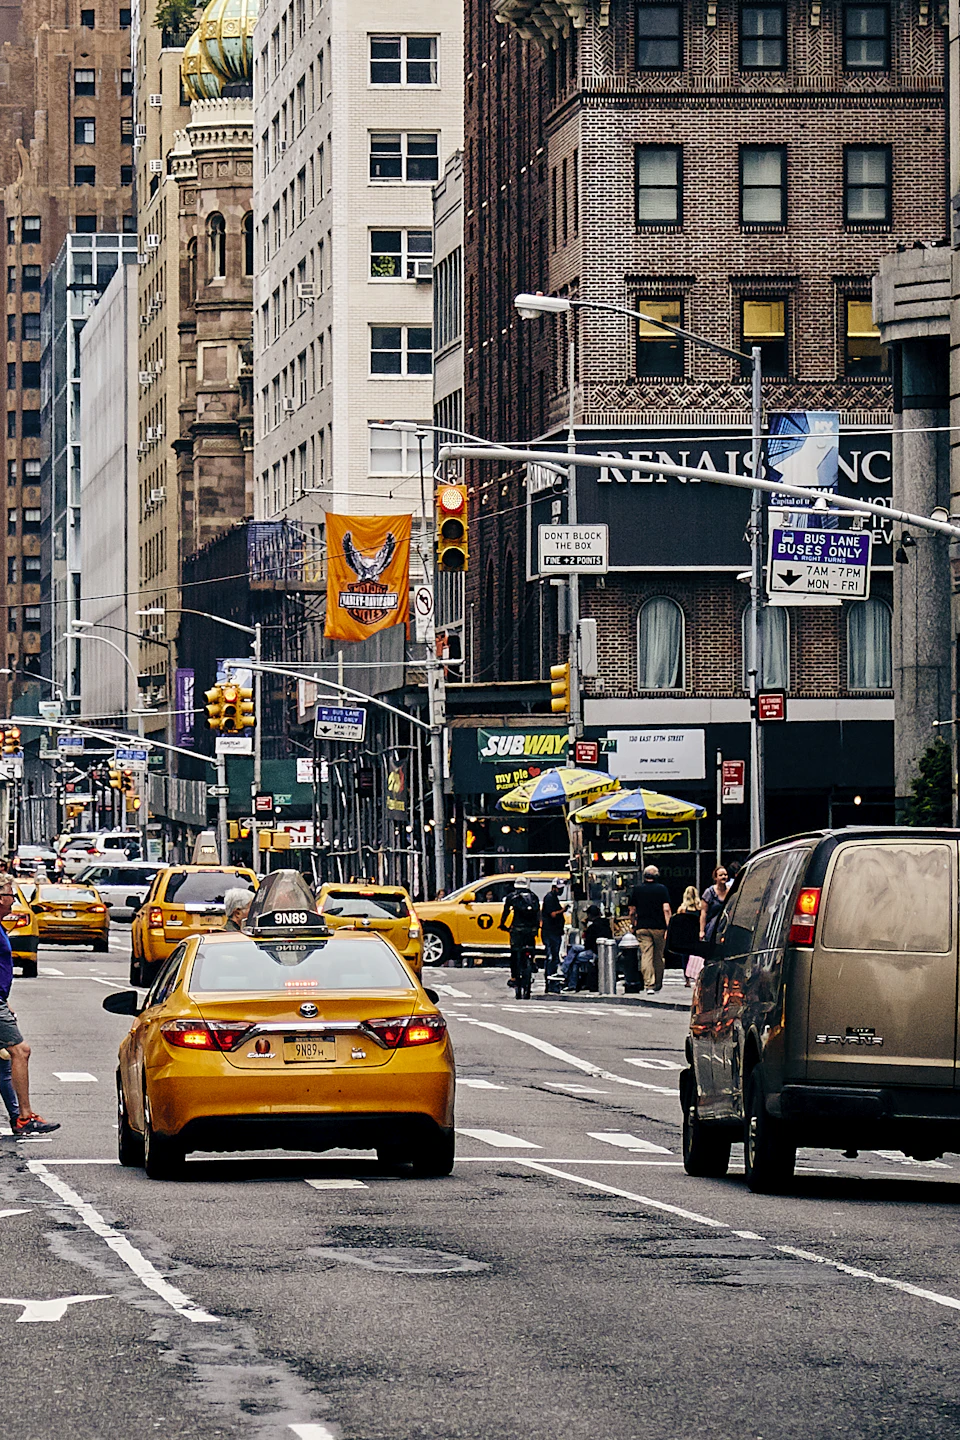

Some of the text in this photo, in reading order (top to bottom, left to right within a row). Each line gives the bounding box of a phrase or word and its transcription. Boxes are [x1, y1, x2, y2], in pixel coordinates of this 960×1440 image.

[771, 498, 795, 507] Capital
[544, 532, 602, 540] DON'T BLOCK
[804, 533, 860, 547] BUS LANE
[555, 542, 592, 550] THE BOX
[777, 544, 862, 558] BUSES ONLY
[545, 557, 561, 565] FINE
[576, 557, 601, 565] POINTS
[824, 556, 846, 564] TURNS
[806, 565, 828, 576] 7AM
[807, 578, 829, 589] MON
[841, 580, 858, 591] FRI
[353, 608, 382, 621] CYCLES
[667, 734, 684, 742] STREET
[481, 734, 569, 757] SUBWAY
[495, 768, 528, 784] my pie
[274, 912, 308, 925] 9N89
[815, 1034, 884, 1046] SAVANA
[295, 1043, 324, 1056] 9N89H
